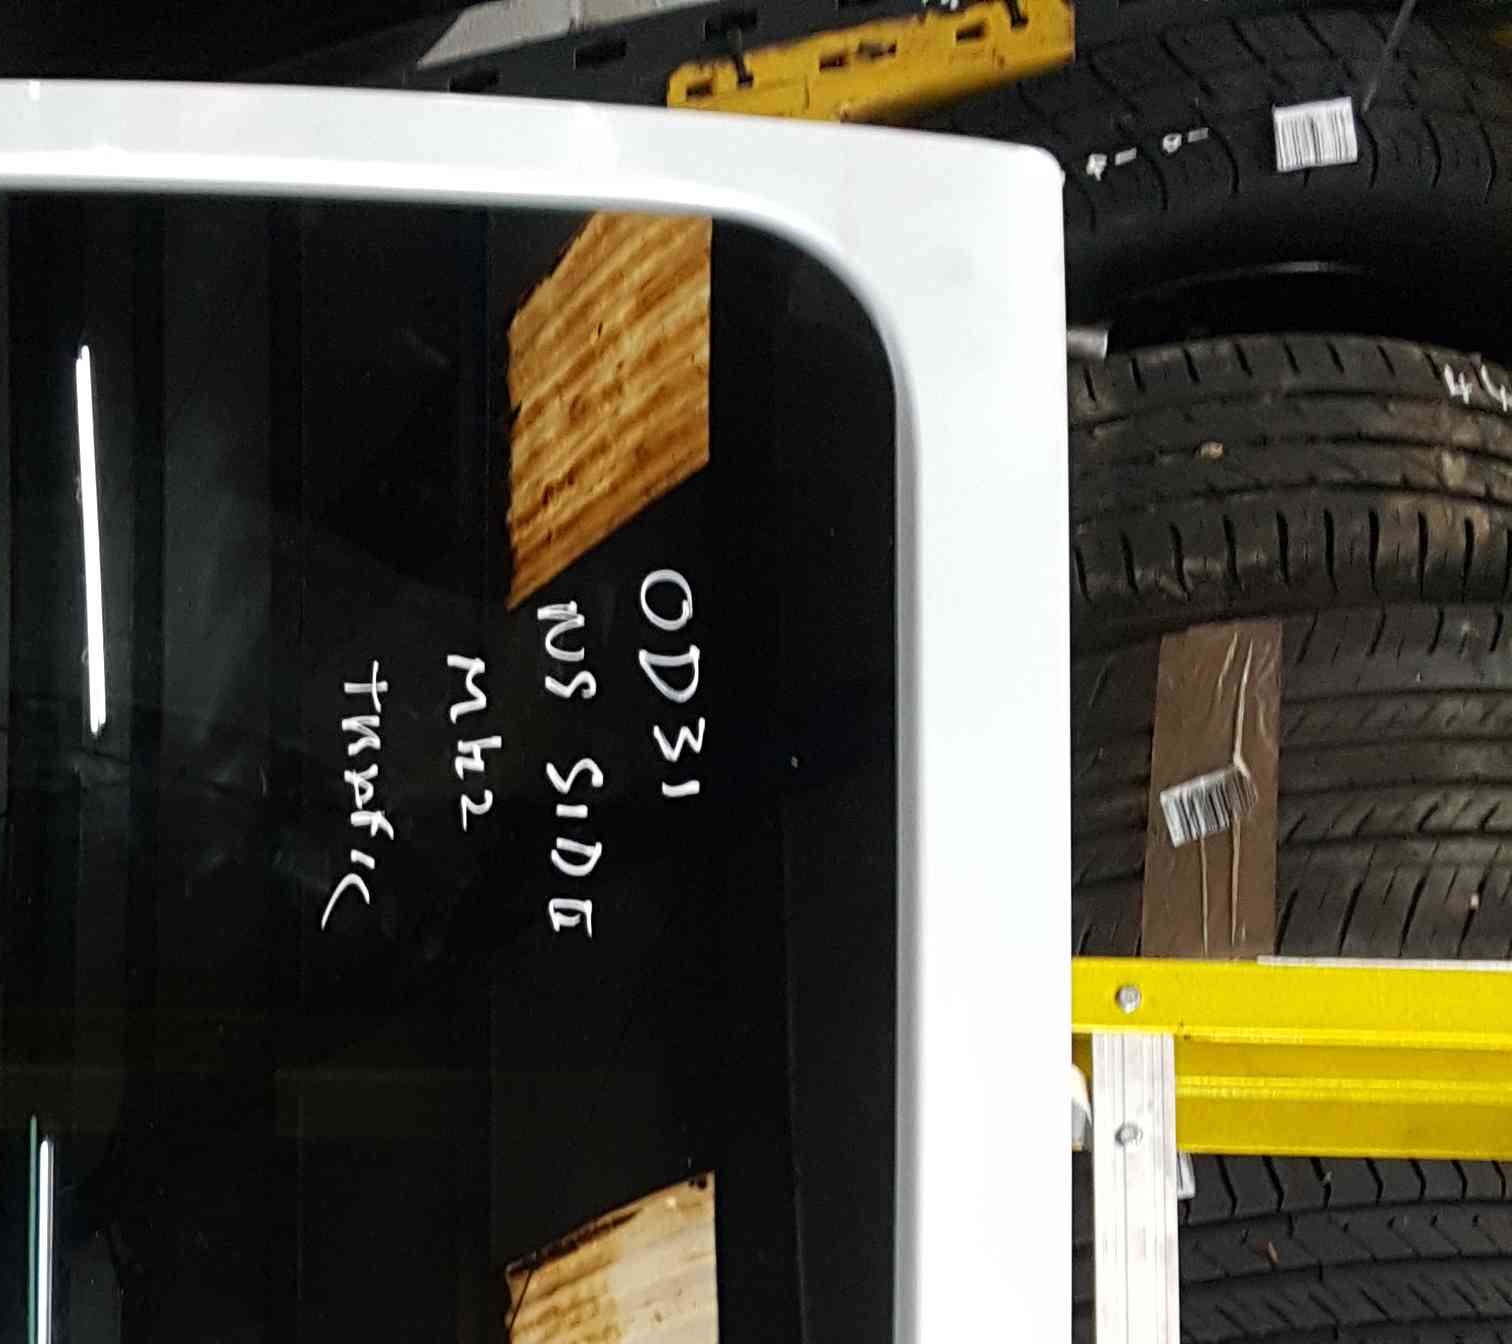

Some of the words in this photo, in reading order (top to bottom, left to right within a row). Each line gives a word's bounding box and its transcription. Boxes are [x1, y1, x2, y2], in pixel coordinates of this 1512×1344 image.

[537, 601, 596, 698] NS
[639, 570, 705, 797] OD31
[546, 758, 603, 937] SIDE
